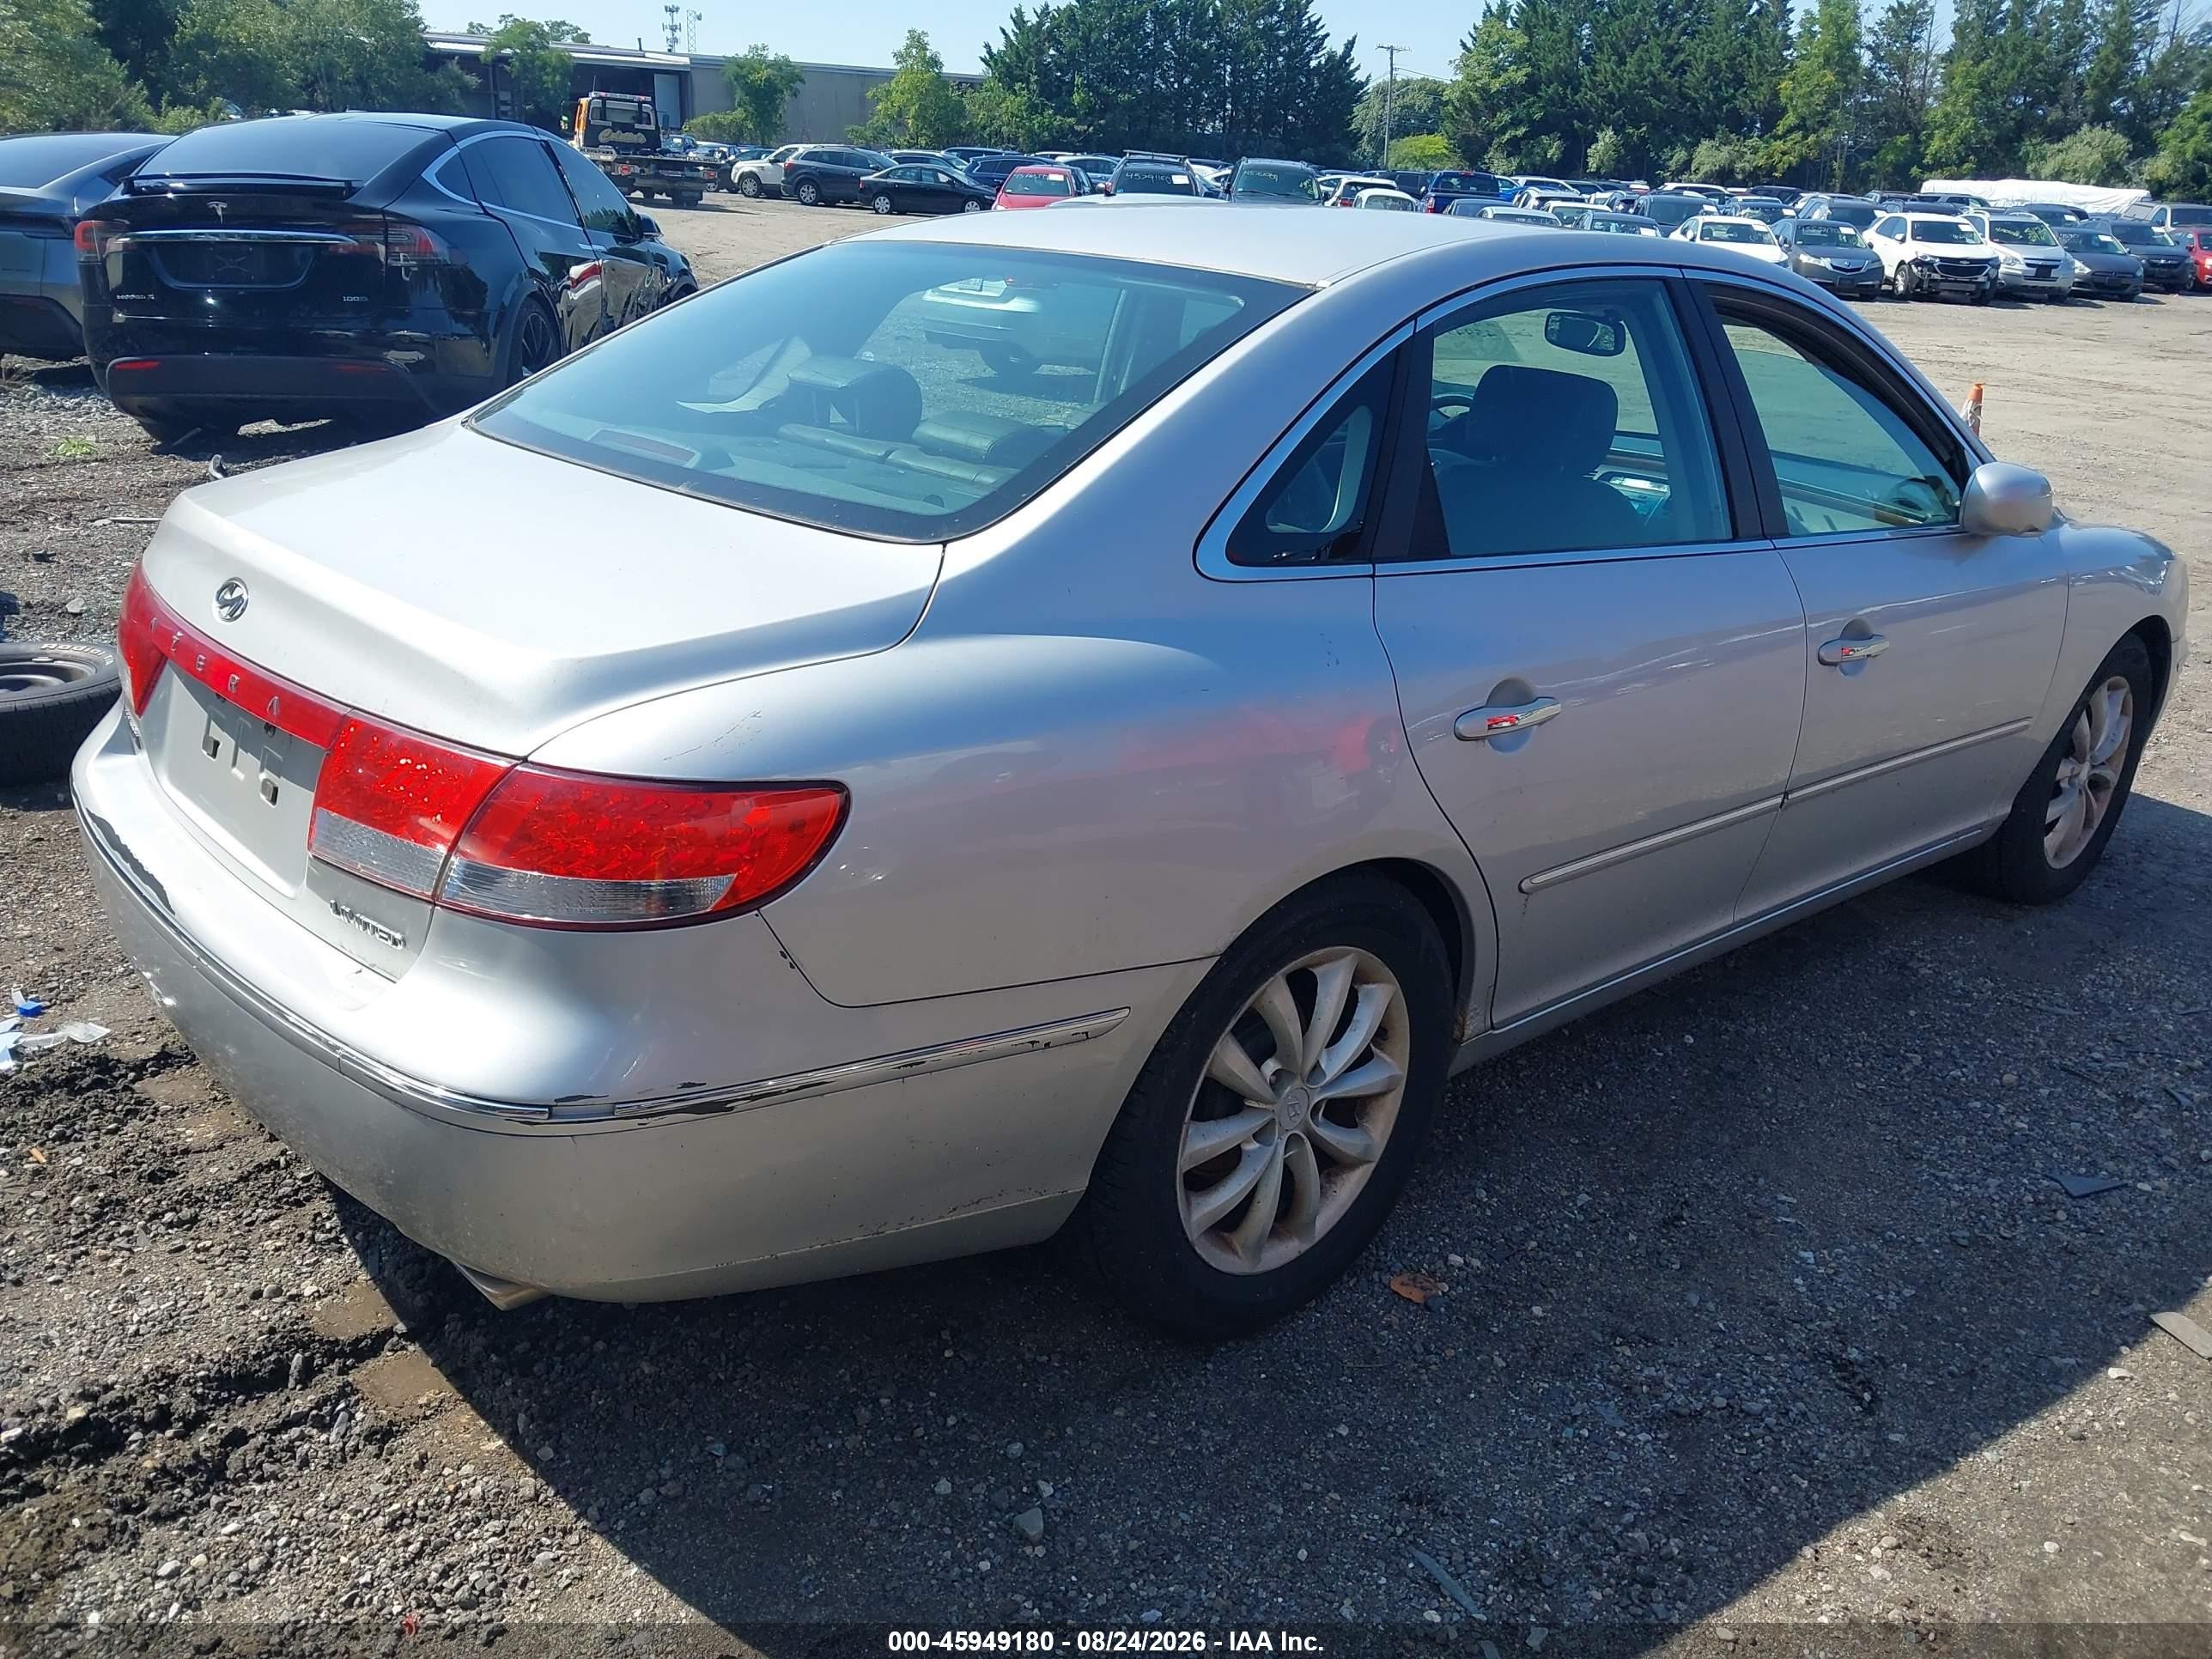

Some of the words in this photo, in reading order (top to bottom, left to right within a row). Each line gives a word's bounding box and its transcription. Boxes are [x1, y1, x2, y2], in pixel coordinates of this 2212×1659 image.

[40, 643, 106, 656] Radial
[149, 617, 280, 716] AZERA
[329, 899, 406, 950] LIMITED
